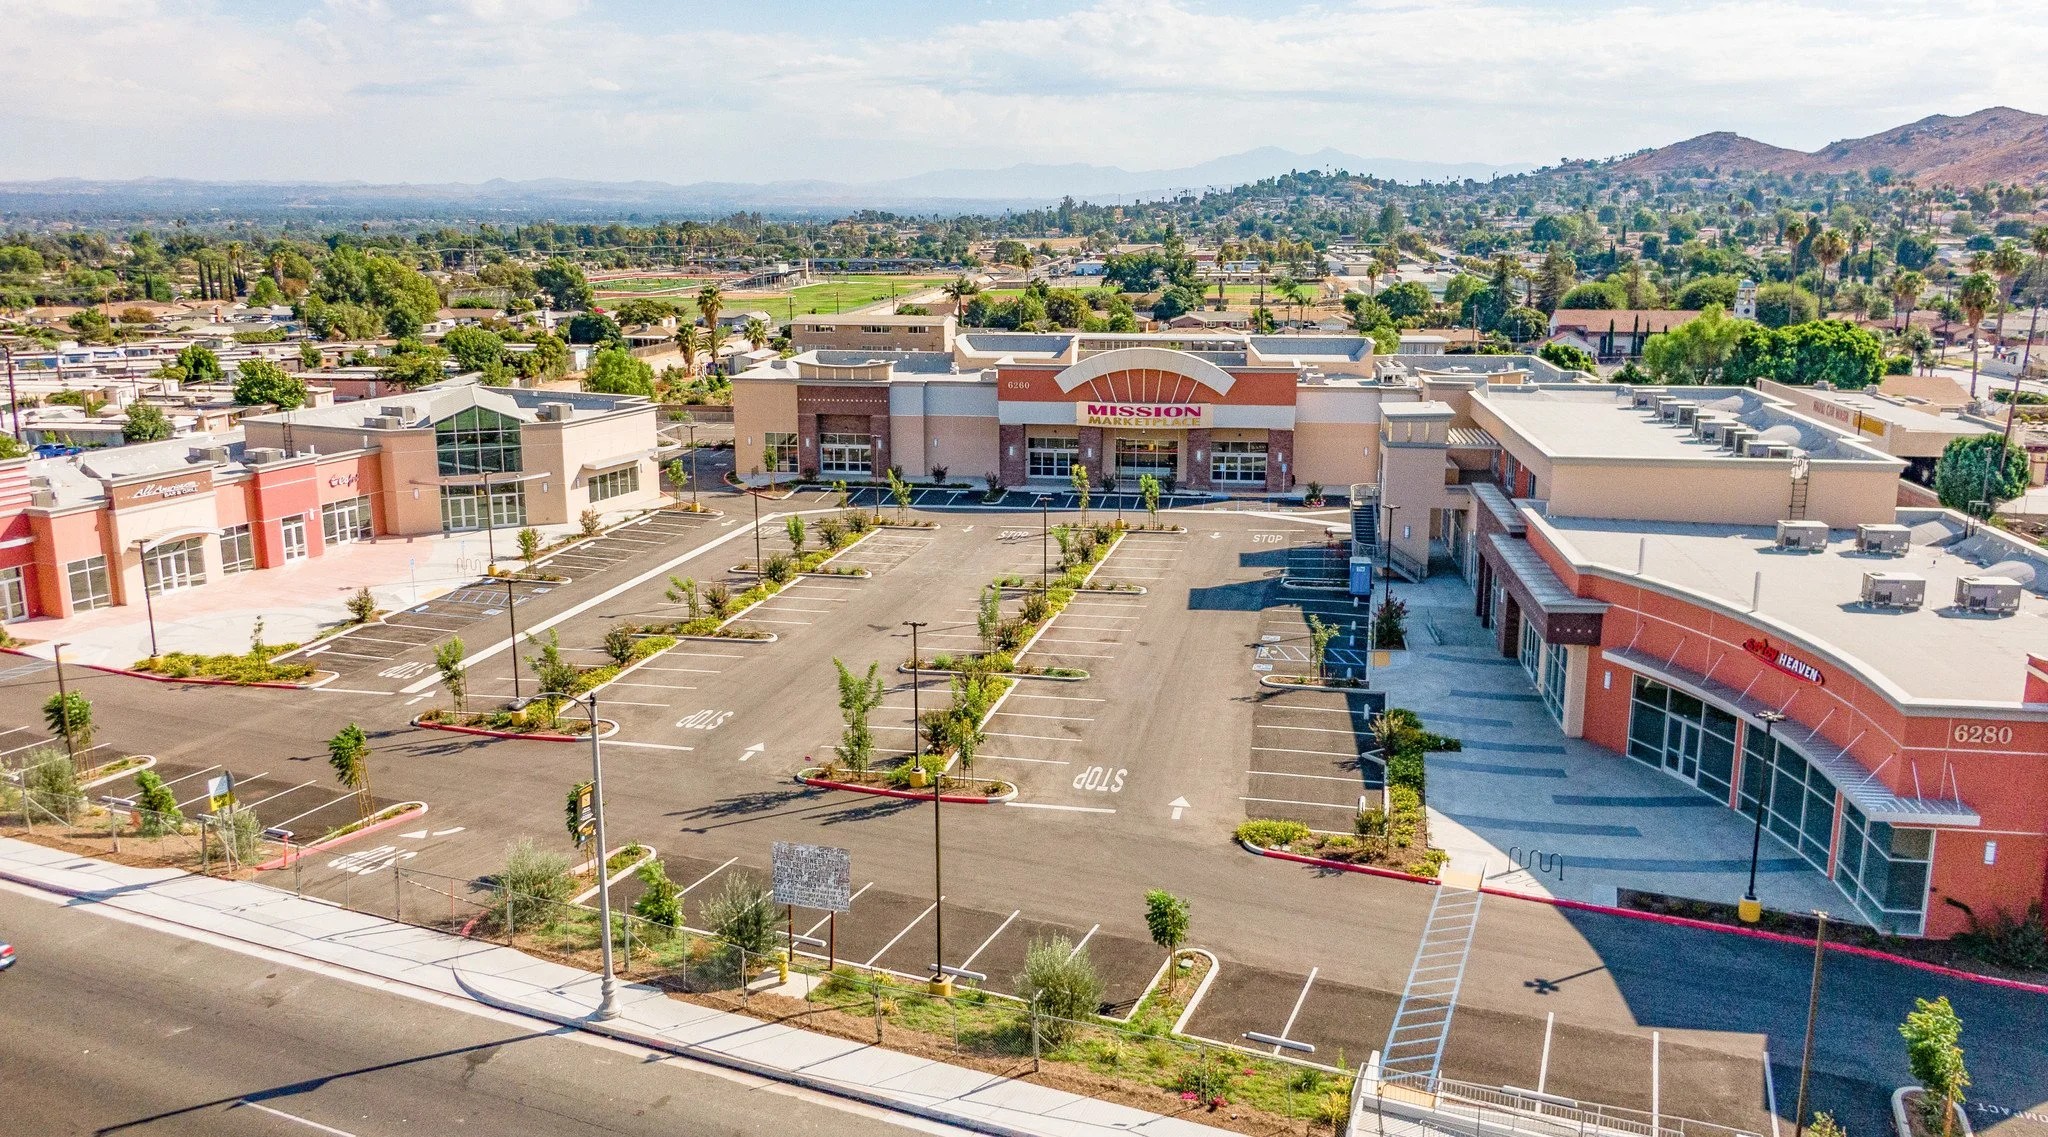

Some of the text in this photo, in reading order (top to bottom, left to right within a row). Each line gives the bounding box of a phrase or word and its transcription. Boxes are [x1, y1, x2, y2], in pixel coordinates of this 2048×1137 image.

[1008, 381, 1030, 389] 6260
[1087, 404, 1201, 418] MISSION
[1088, 416, 1201, 427] MARKETPLACE
[131, 484, 155, 499] All
[997, 530, 1029, 538] STOP
[1252, 534, 1284, 543] STOP
[377, 661, 436, 680] STOP
[1778, 652, 1820, 682] HEAVEN
[675, 709, 735, 731] STOP
[1954, 724, 2013, 744] 6280
[1072, 765, 1129, 793] STOP
[327, 844, 419, 876] STOP
[1977, 1103, 2048, 1123] OMPACT
